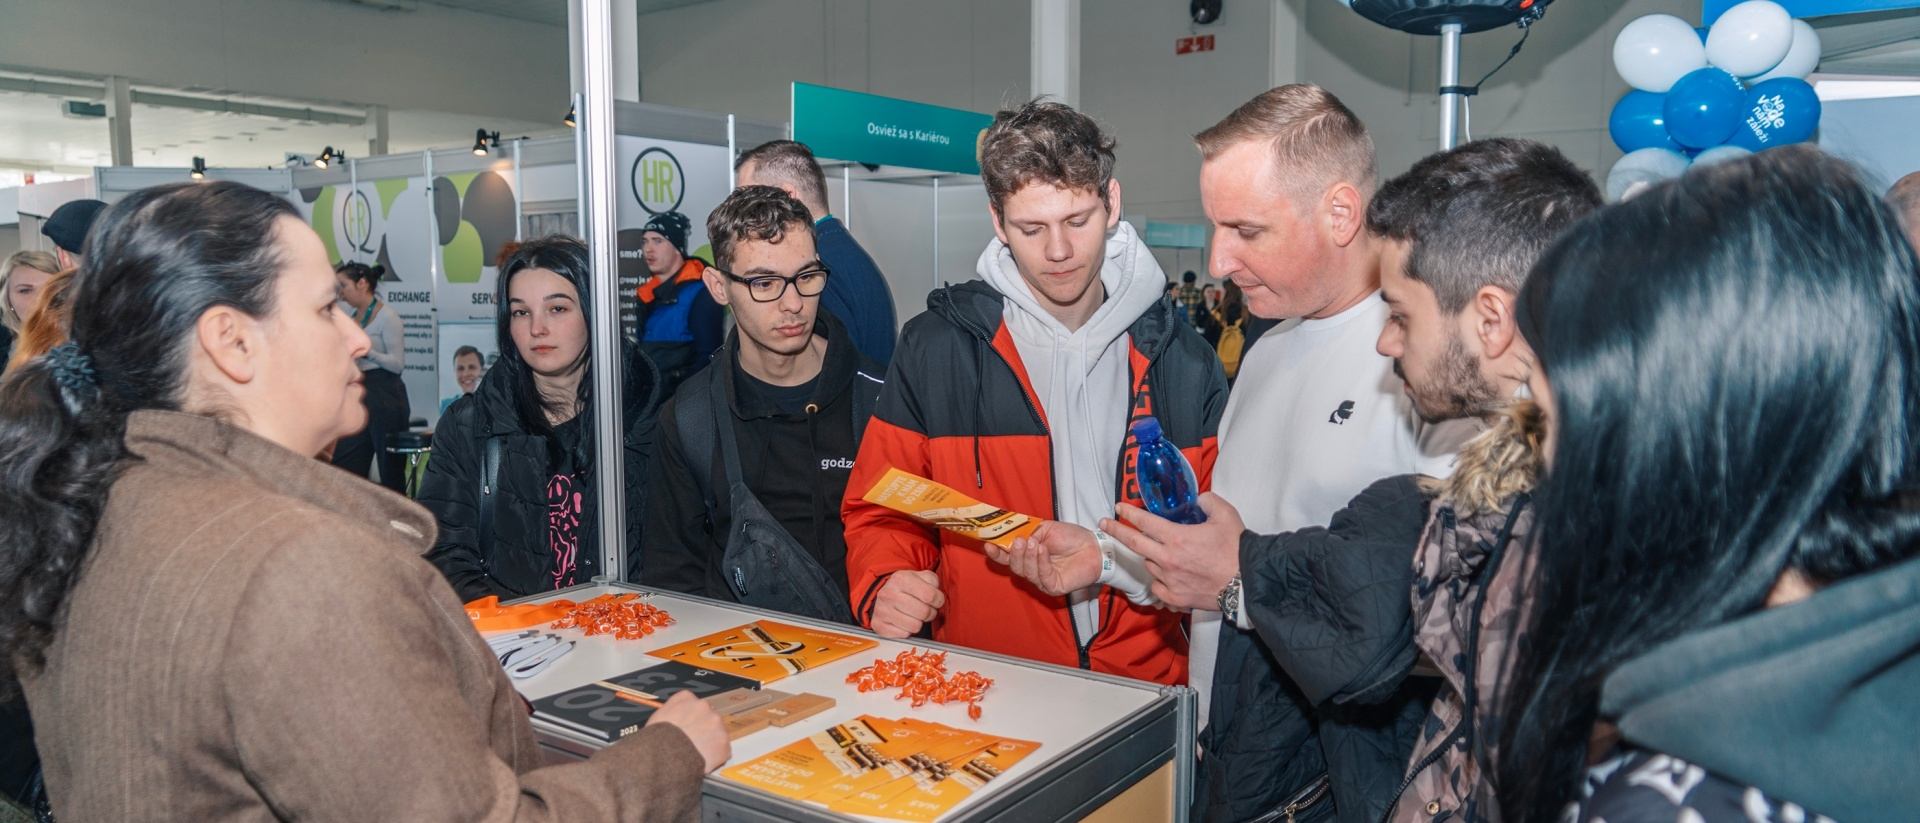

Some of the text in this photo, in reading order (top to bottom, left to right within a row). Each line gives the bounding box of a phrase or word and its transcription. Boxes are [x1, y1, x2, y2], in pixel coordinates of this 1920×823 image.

[1771, 94, 1785, 110] Na
[1752, 106, 1772, 129] nám
[867, 122, 896, 138] Osviež
[898, 129, 908, 139] sa
[909, 130, 914, 140] s
[642, 159, 675, 203] HR
[619, 249, 642, 259] sme?
[388, 291, 431, 303] EXCHANGE
